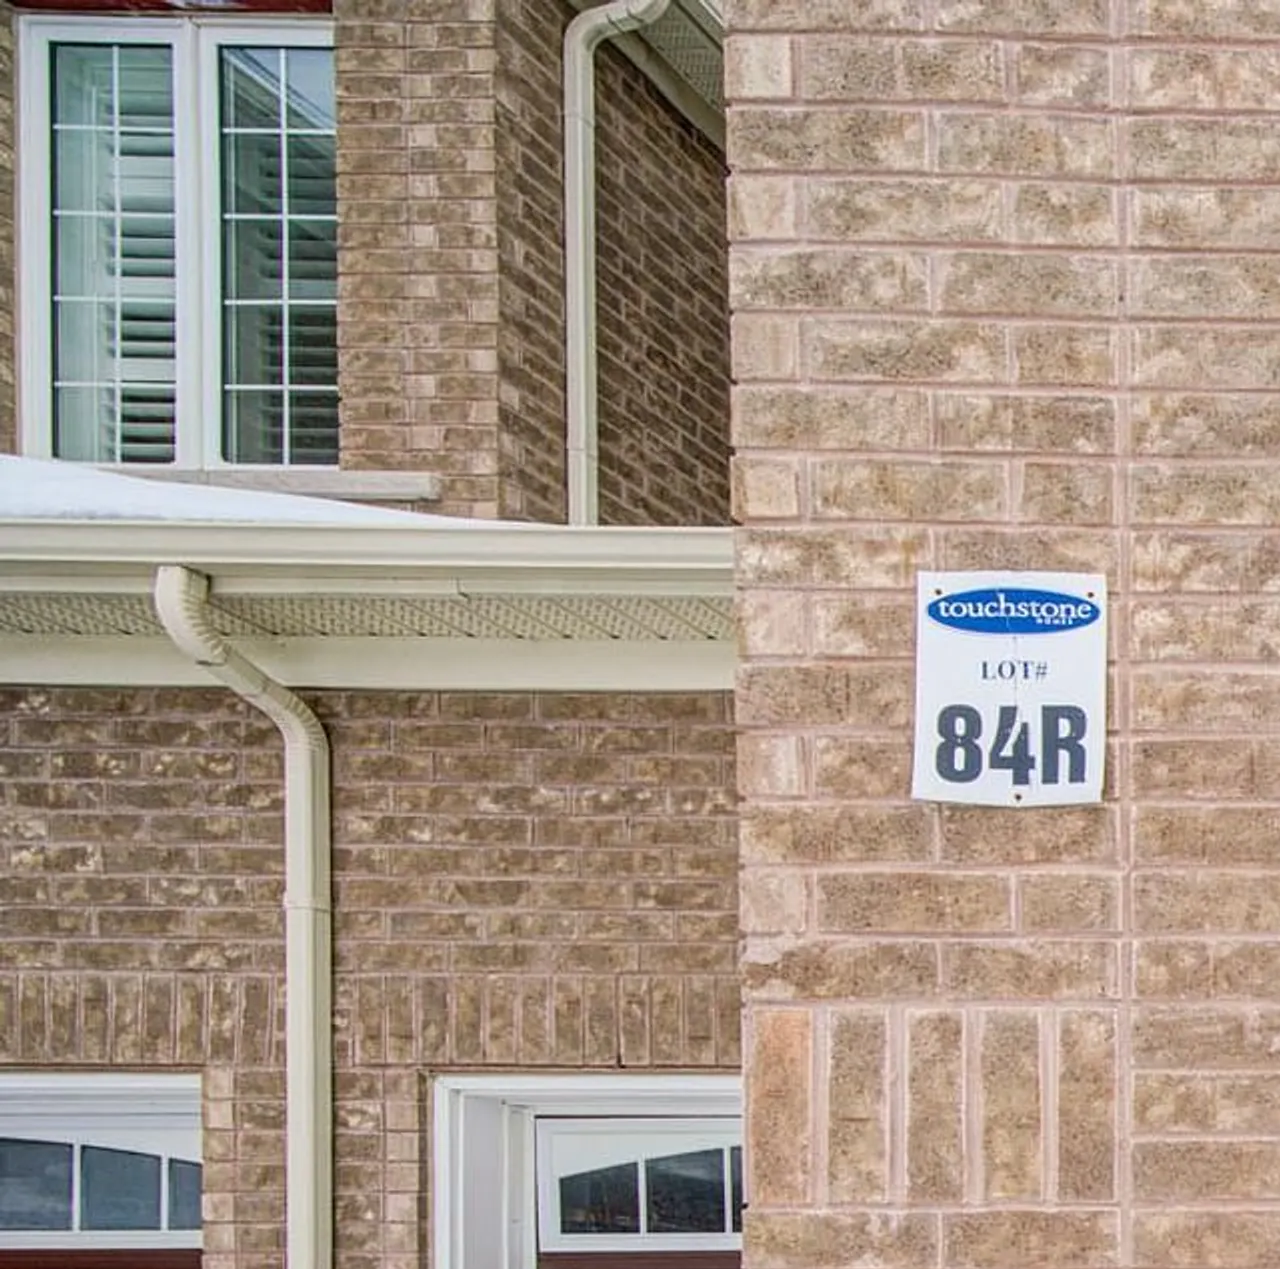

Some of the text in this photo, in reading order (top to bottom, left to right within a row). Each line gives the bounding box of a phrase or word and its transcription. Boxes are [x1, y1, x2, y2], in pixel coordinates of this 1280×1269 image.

[938, 593, 1092, 619] touchstone
[980, 660, 1048, 680] LOT#
[935, 704, 1088, 785] 84R
